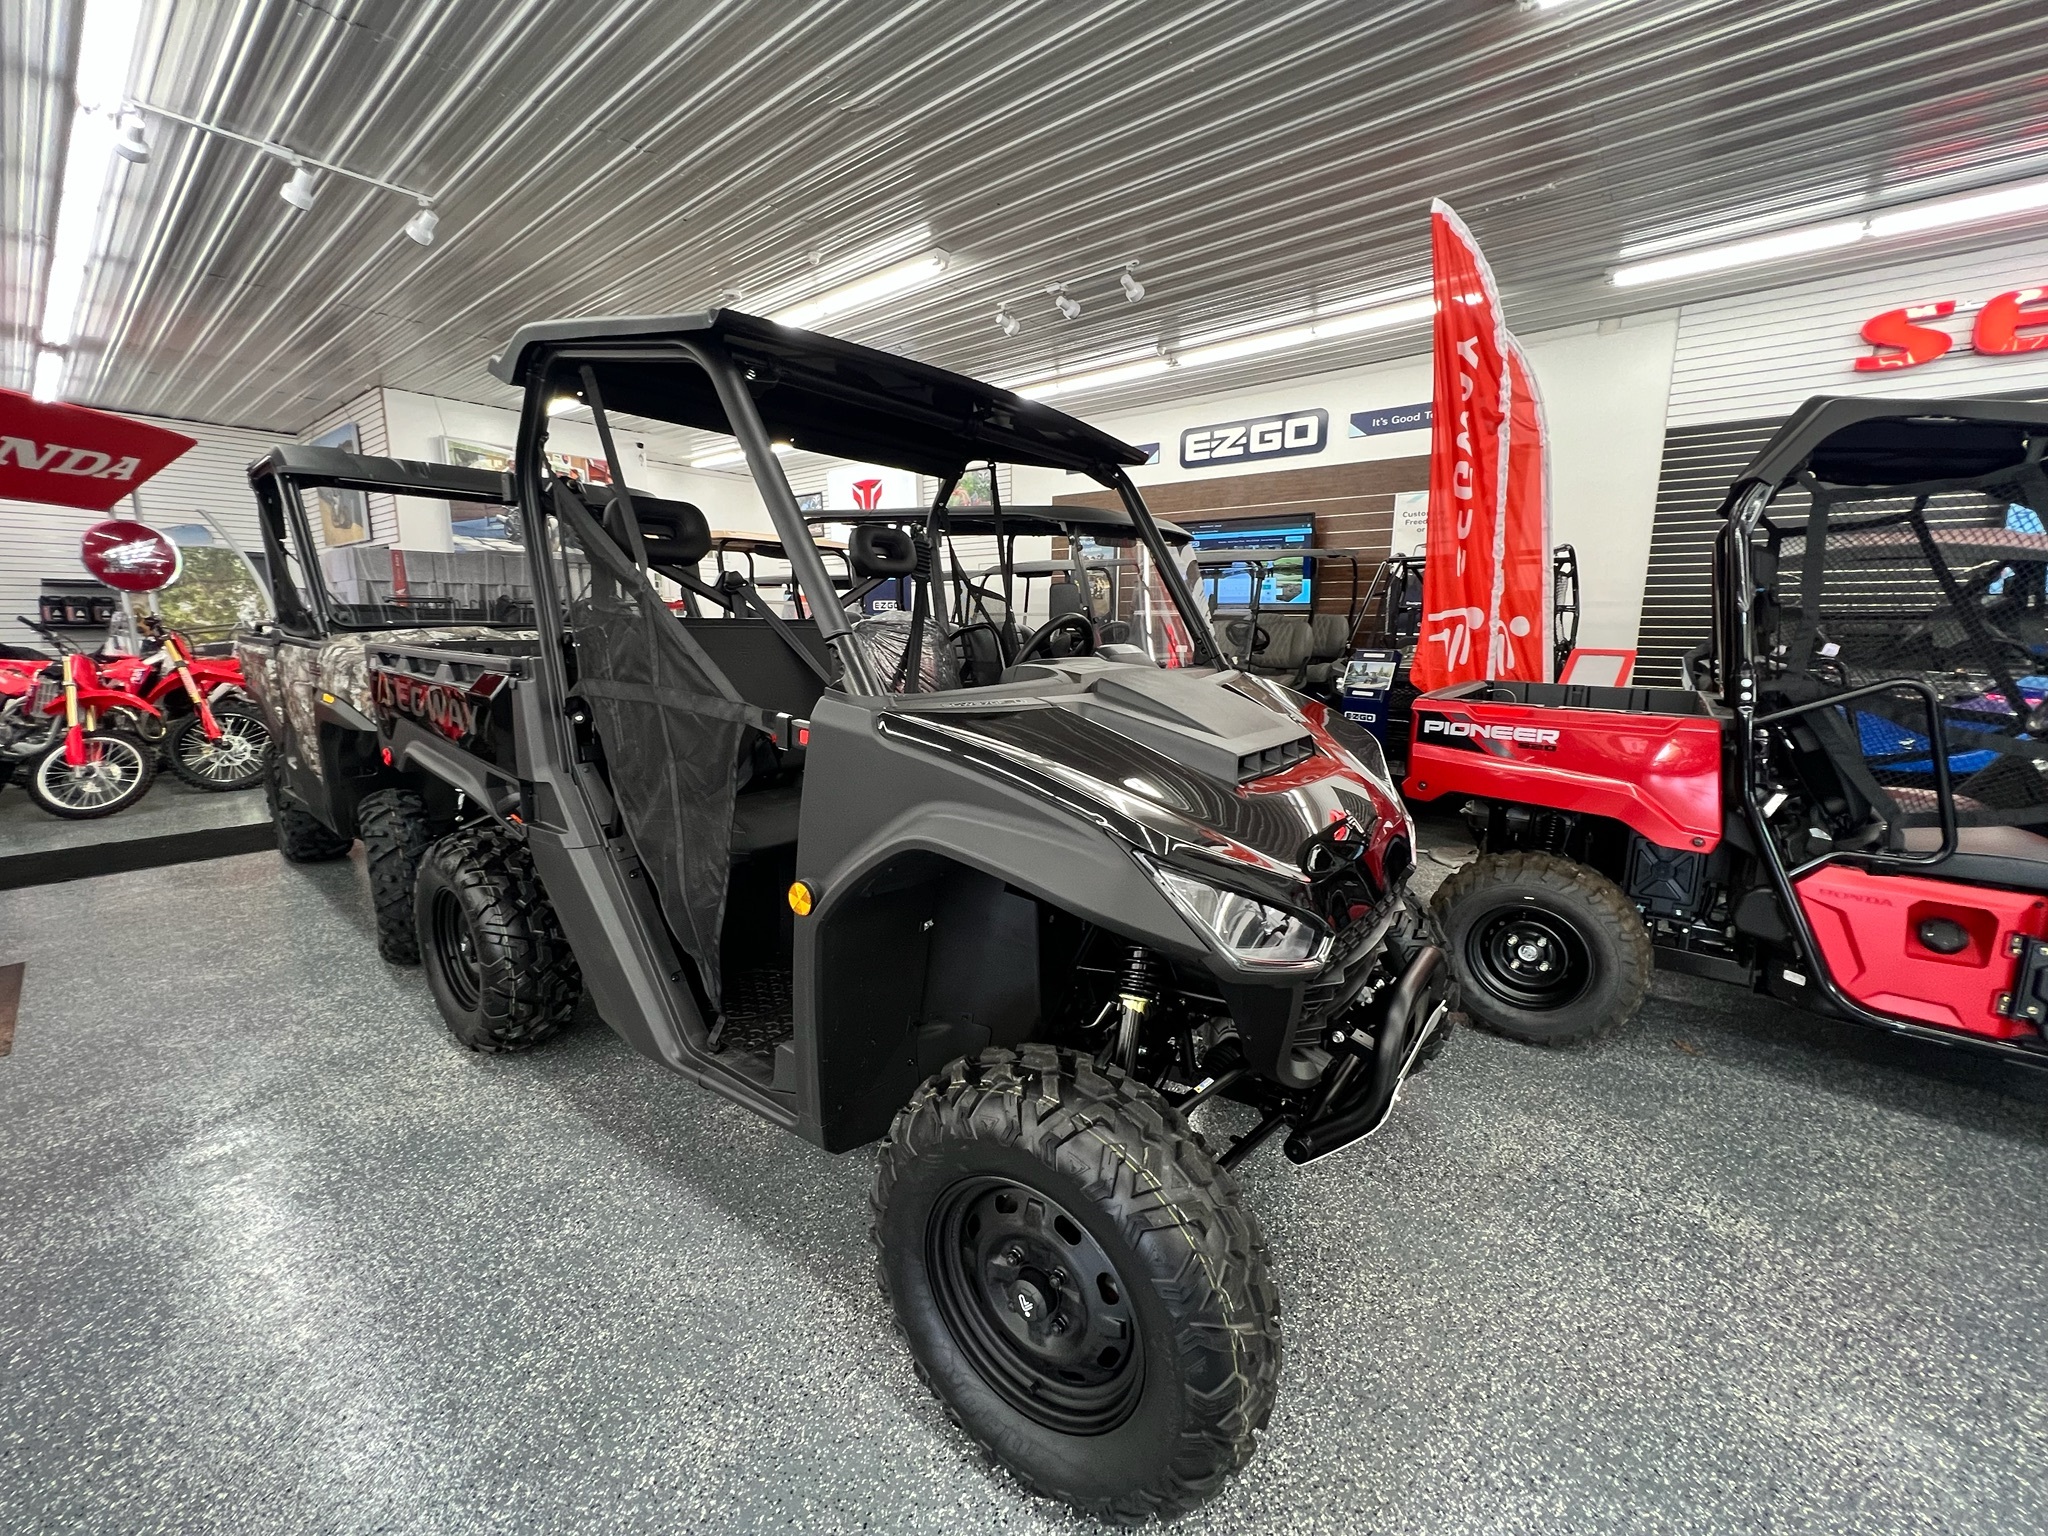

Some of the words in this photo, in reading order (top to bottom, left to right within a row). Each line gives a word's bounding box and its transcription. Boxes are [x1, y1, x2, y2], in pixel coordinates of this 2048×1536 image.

[1372, 417, 1388, 427] It's
[1391, 412, 1421, 424] Good
[1185, 415, 1319, 462] EZGO
[1424, 720, 1560, 744] PIONEER
